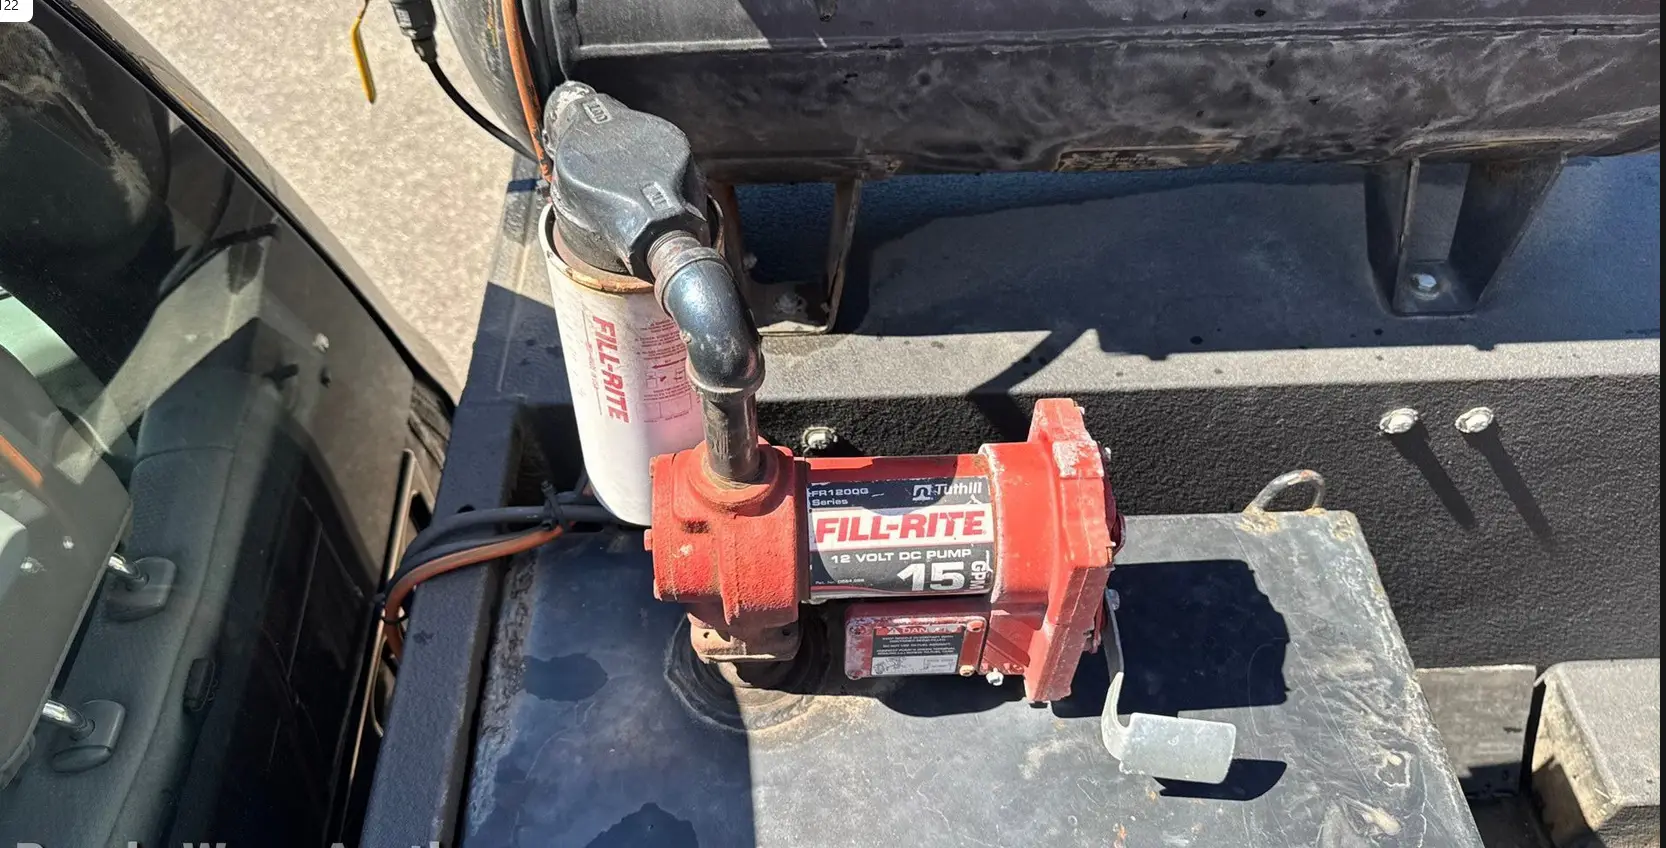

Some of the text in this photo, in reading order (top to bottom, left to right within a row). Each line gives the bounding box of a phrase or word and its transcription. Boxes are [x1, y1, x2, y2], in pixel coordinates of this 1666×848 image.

[592, 316, 630, 424] FILL-RITE
[937, 482, 982, 496] Tuthill
[811, 498, 848, 506] Series
[814, 511, 985, 543] FILL-RITE
[831, 548, 972, 563] 12 VOLT DC PUMP
[897, 560, 987, 592] 15 GPM
